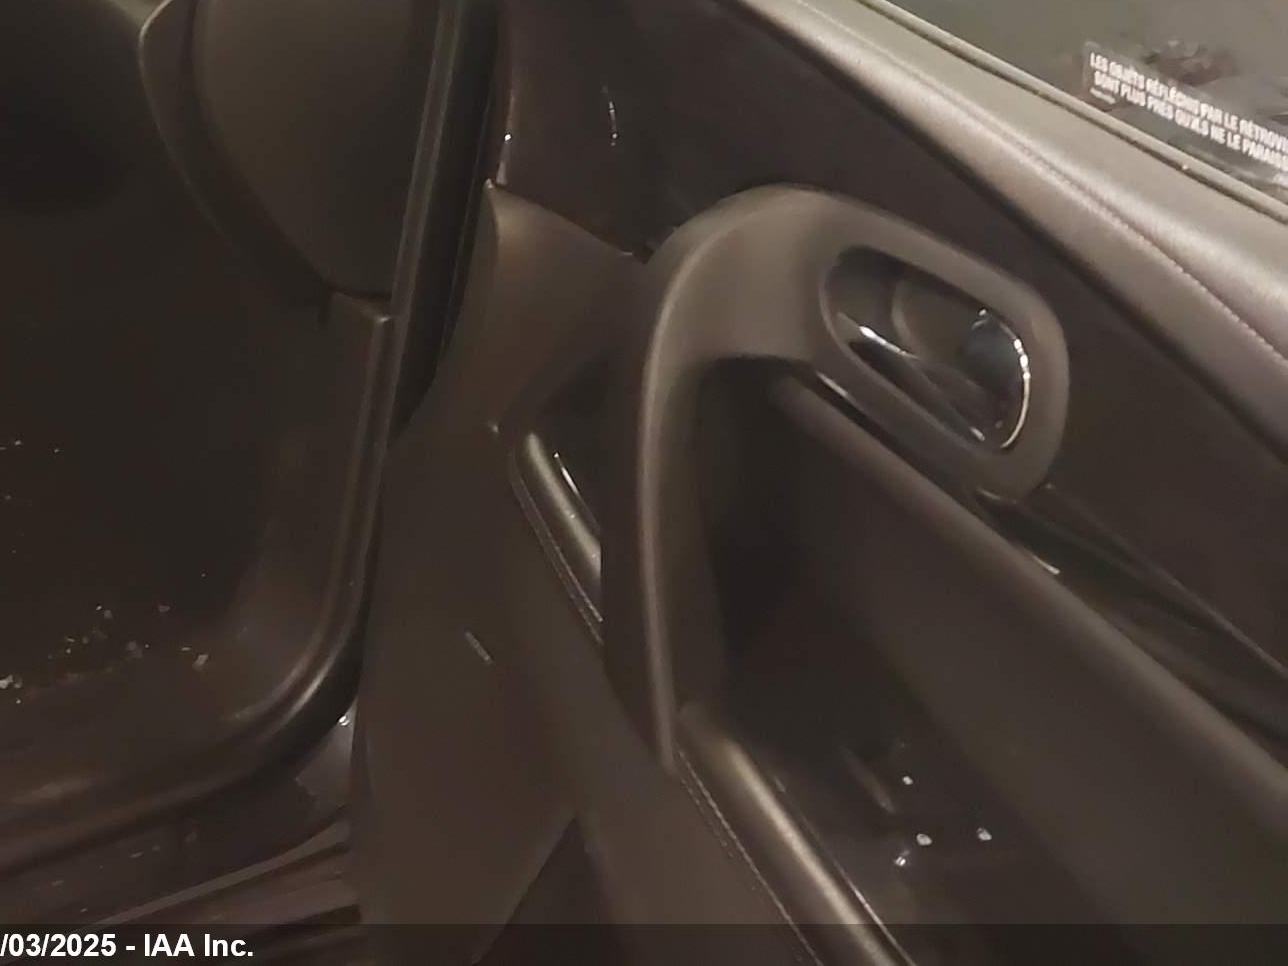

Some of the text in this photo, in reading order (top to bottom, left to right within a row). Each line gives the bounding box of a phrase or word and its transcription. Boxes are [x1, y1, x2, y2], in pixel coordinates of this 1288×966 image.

[1224, 112, 1239, 132] LE
[1210, 124, 1226, 144] NE
[1227, 131, 1241, 151] LE
